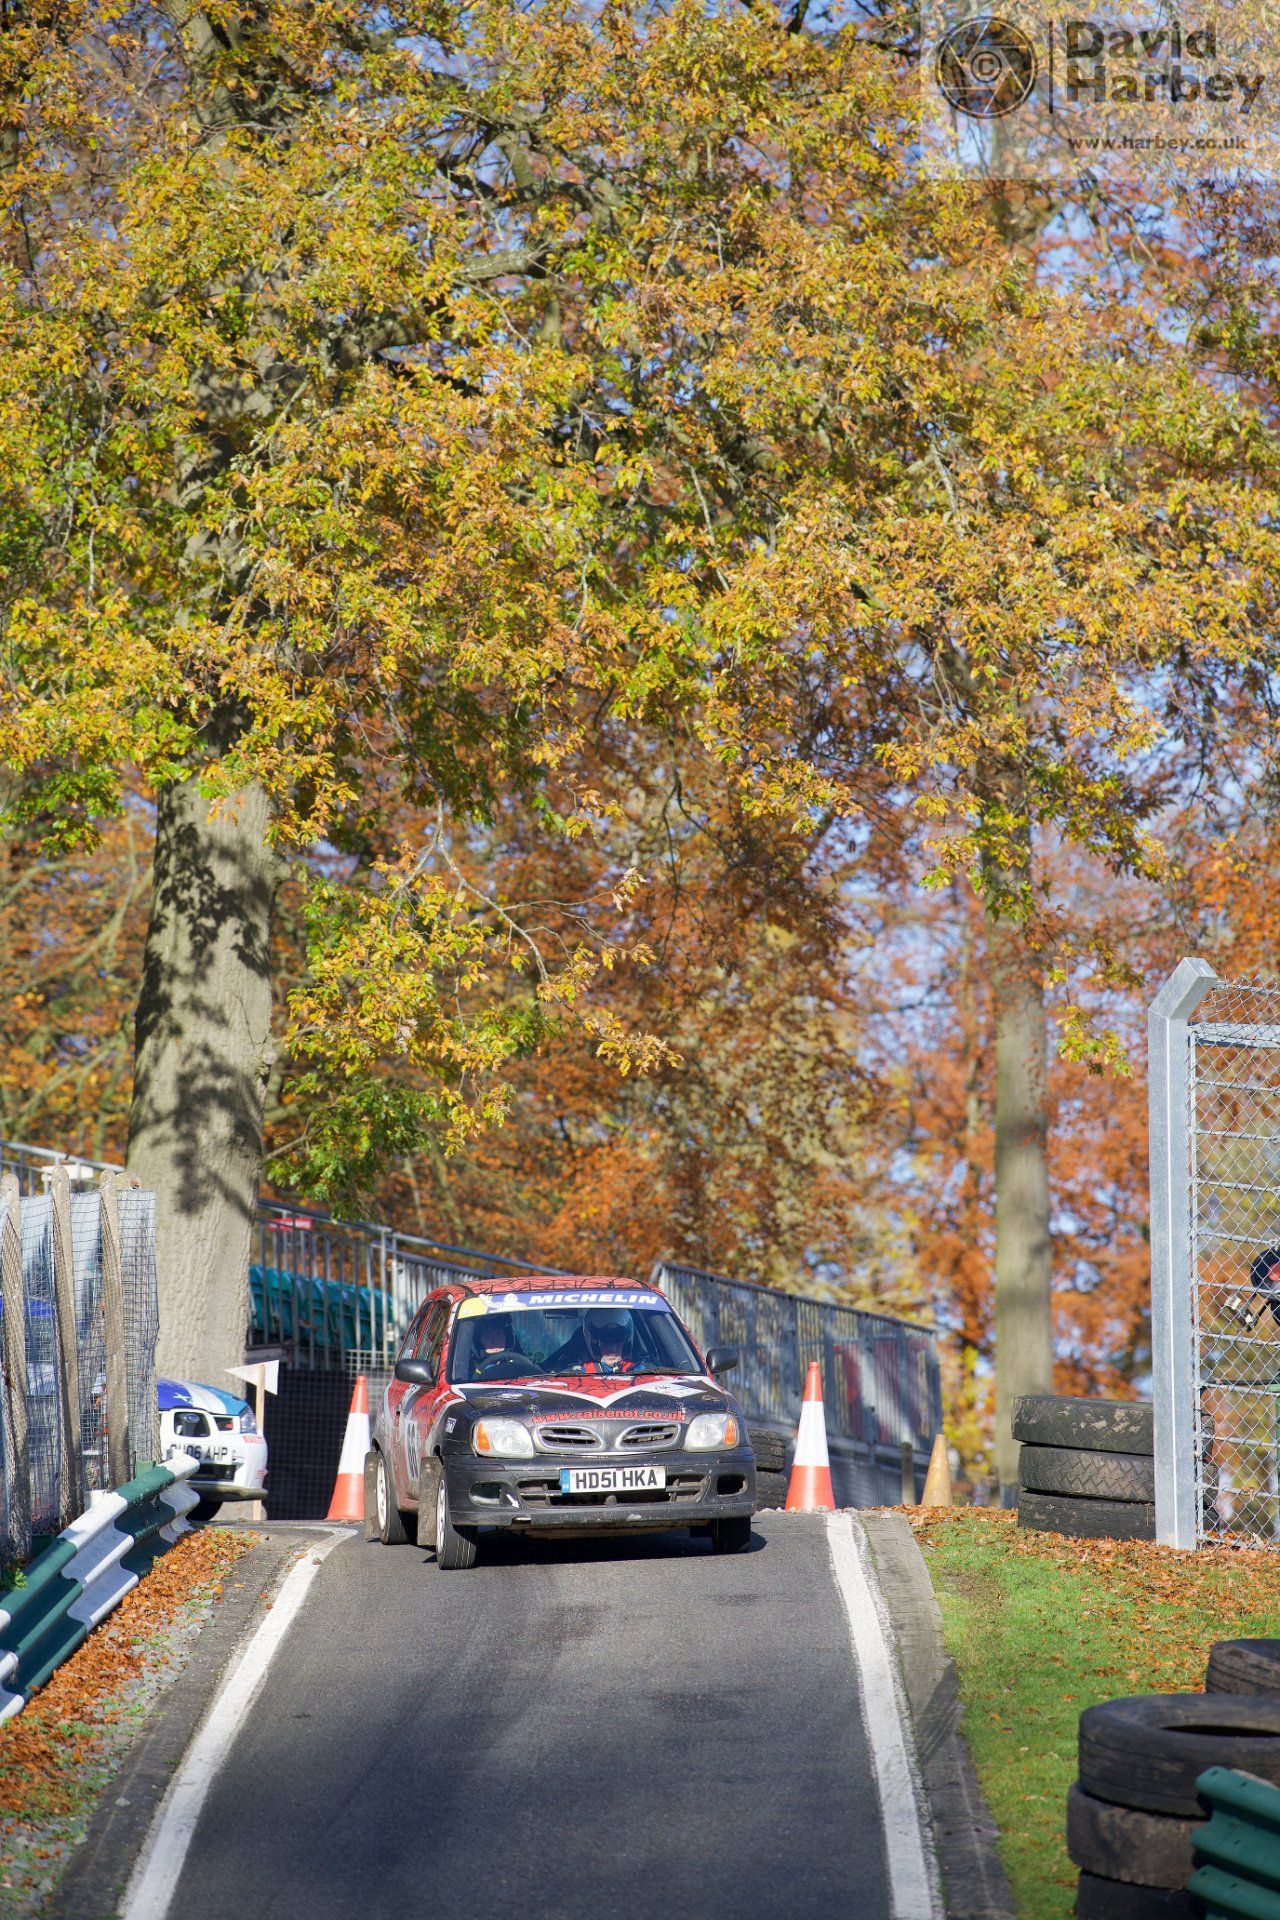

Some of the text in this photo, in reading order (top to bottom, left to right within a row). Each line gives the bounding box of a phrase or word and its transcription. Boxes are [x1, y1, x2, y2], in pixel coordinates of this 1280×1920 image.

[528, 1293, 659, 1305] MICHELIN
[205, 1446, 228, 1461] AHP
[575, 1469, 658, 1489] HD51 HKA
